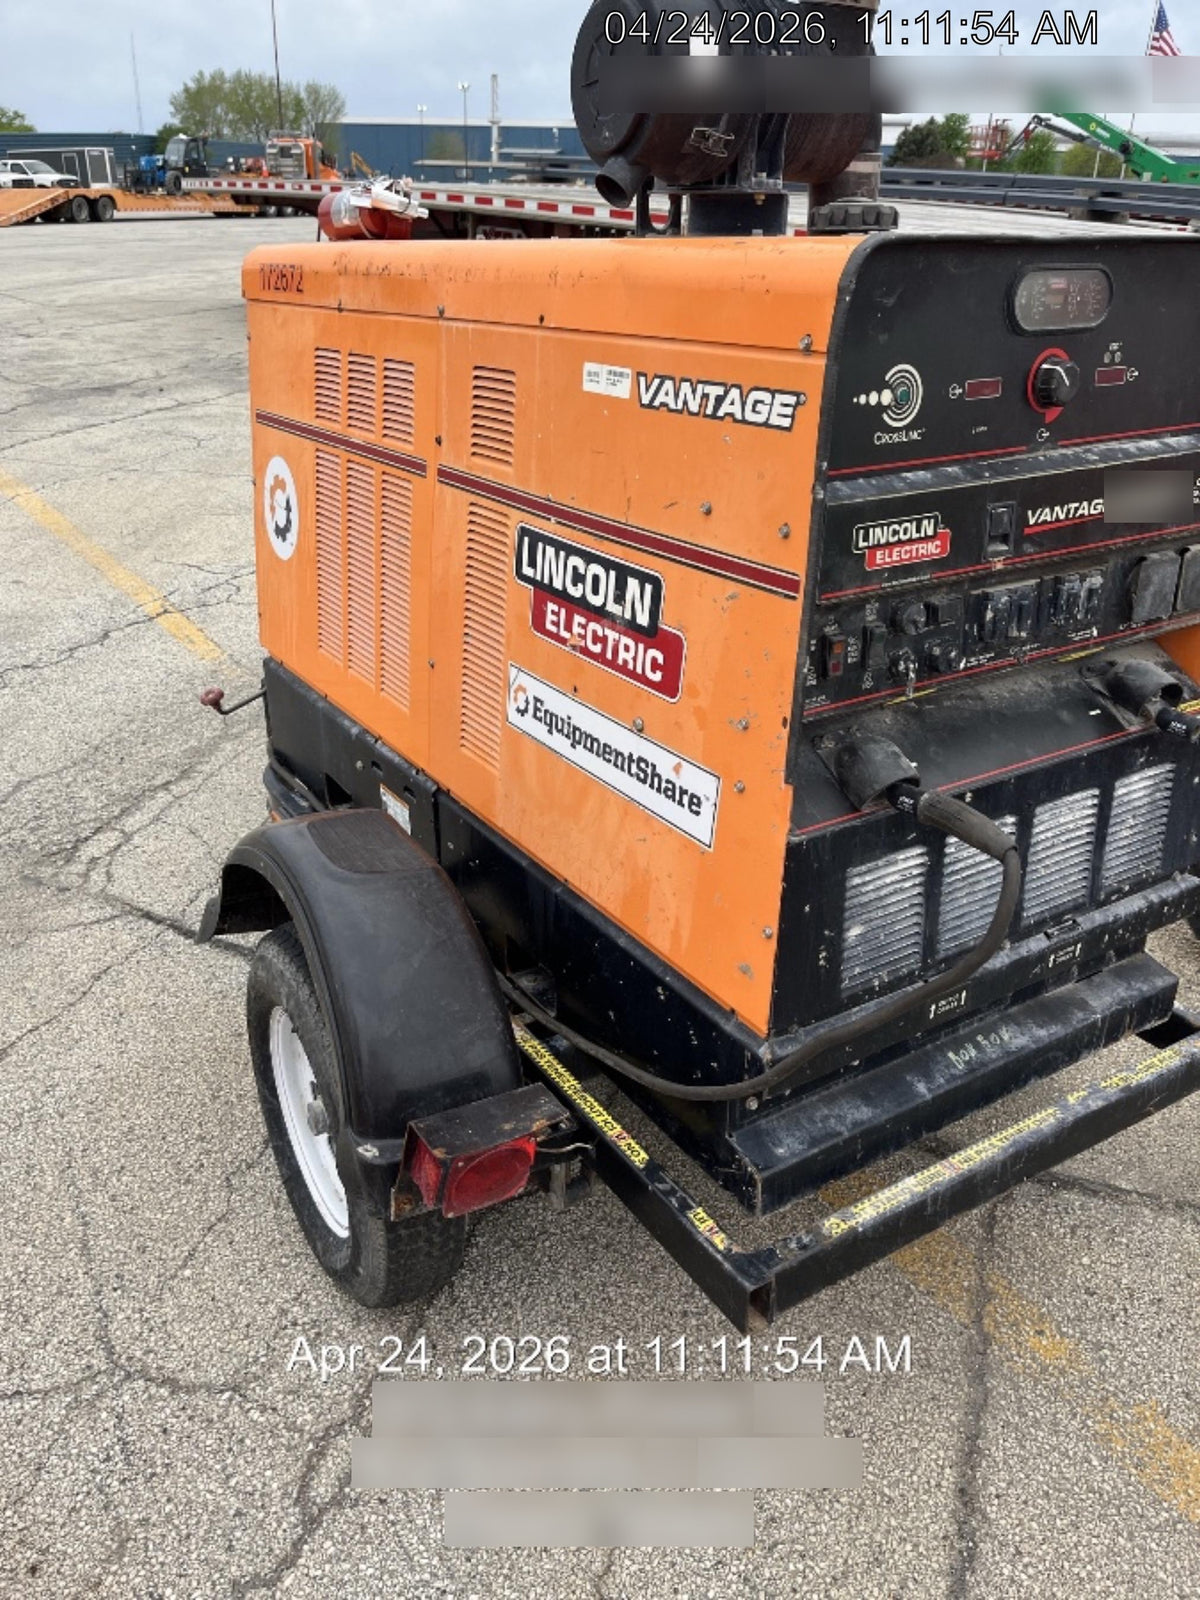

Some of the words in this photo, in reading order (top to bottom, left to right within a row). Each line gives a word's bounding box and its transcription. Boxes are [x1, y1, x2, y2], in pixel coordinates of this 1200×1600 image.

[637, 373, 801, 431] VANTAGE
[858, 518, 935, 548] LINCOLN
[1027, 498, 1105, 525] VANTAG
[875, 540, 941, 564] ELECTRIC
[521, 536, 652, 628] LINCOLN
[544, 601, 664, 683] ELECTRIC
[531, 695, 702, 817] EquipmentShare
